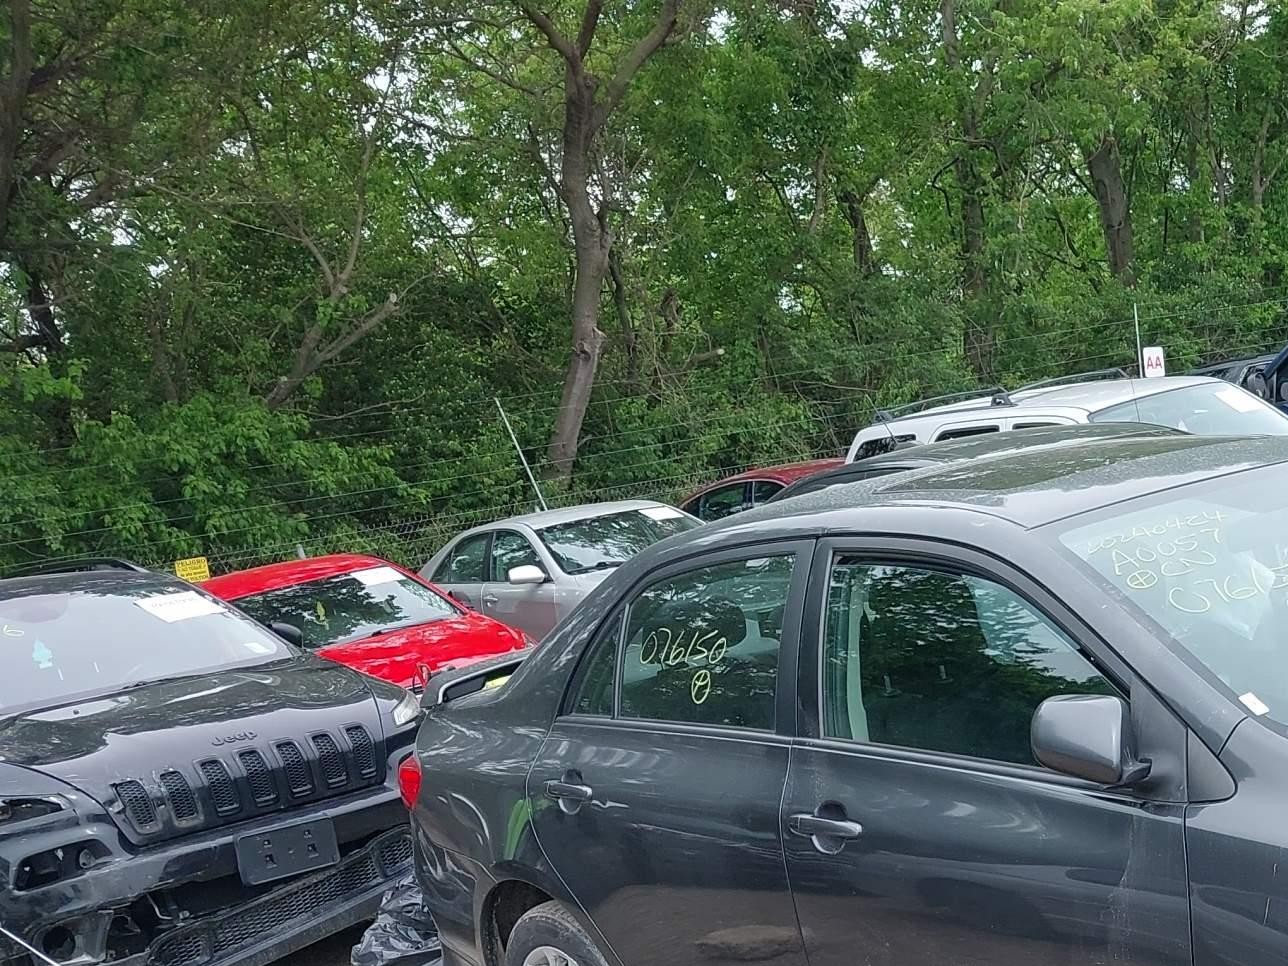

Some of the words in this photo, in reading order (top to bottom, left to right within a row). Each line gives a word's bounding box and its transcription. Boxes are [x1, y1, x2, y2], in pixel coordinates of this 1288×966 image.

[1112, 528, 1221, 576] A0057
[640, 627, 727, 665] 076150
[211, 731, 258, 747] Jeep
